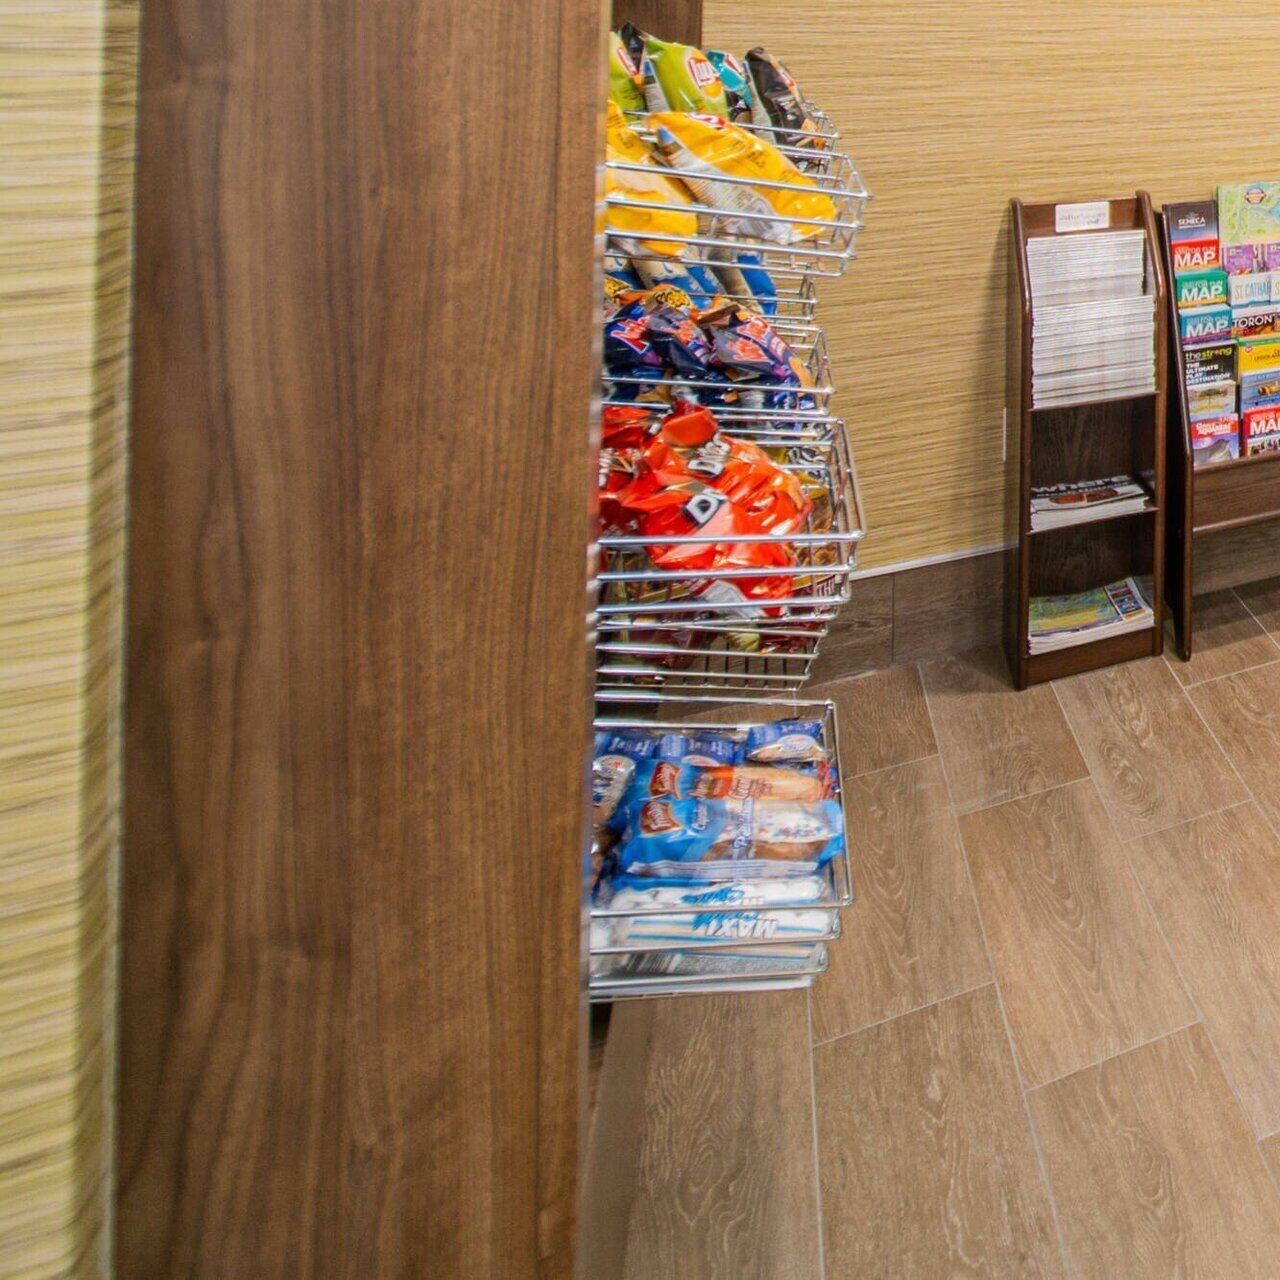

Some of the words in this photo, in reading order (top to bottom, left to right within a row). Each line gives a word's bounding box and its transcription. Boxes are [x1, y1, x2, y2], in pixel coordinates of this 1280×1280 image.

[1178, 217, 1206, 225] SENECA
[1174, 252, 1216, 267] MAP
[1181, 285, 1223, 303] MAP
[1187, 320, 1229, 338] MAP
[1186, 364, 1219, 375] ULTIMATE
